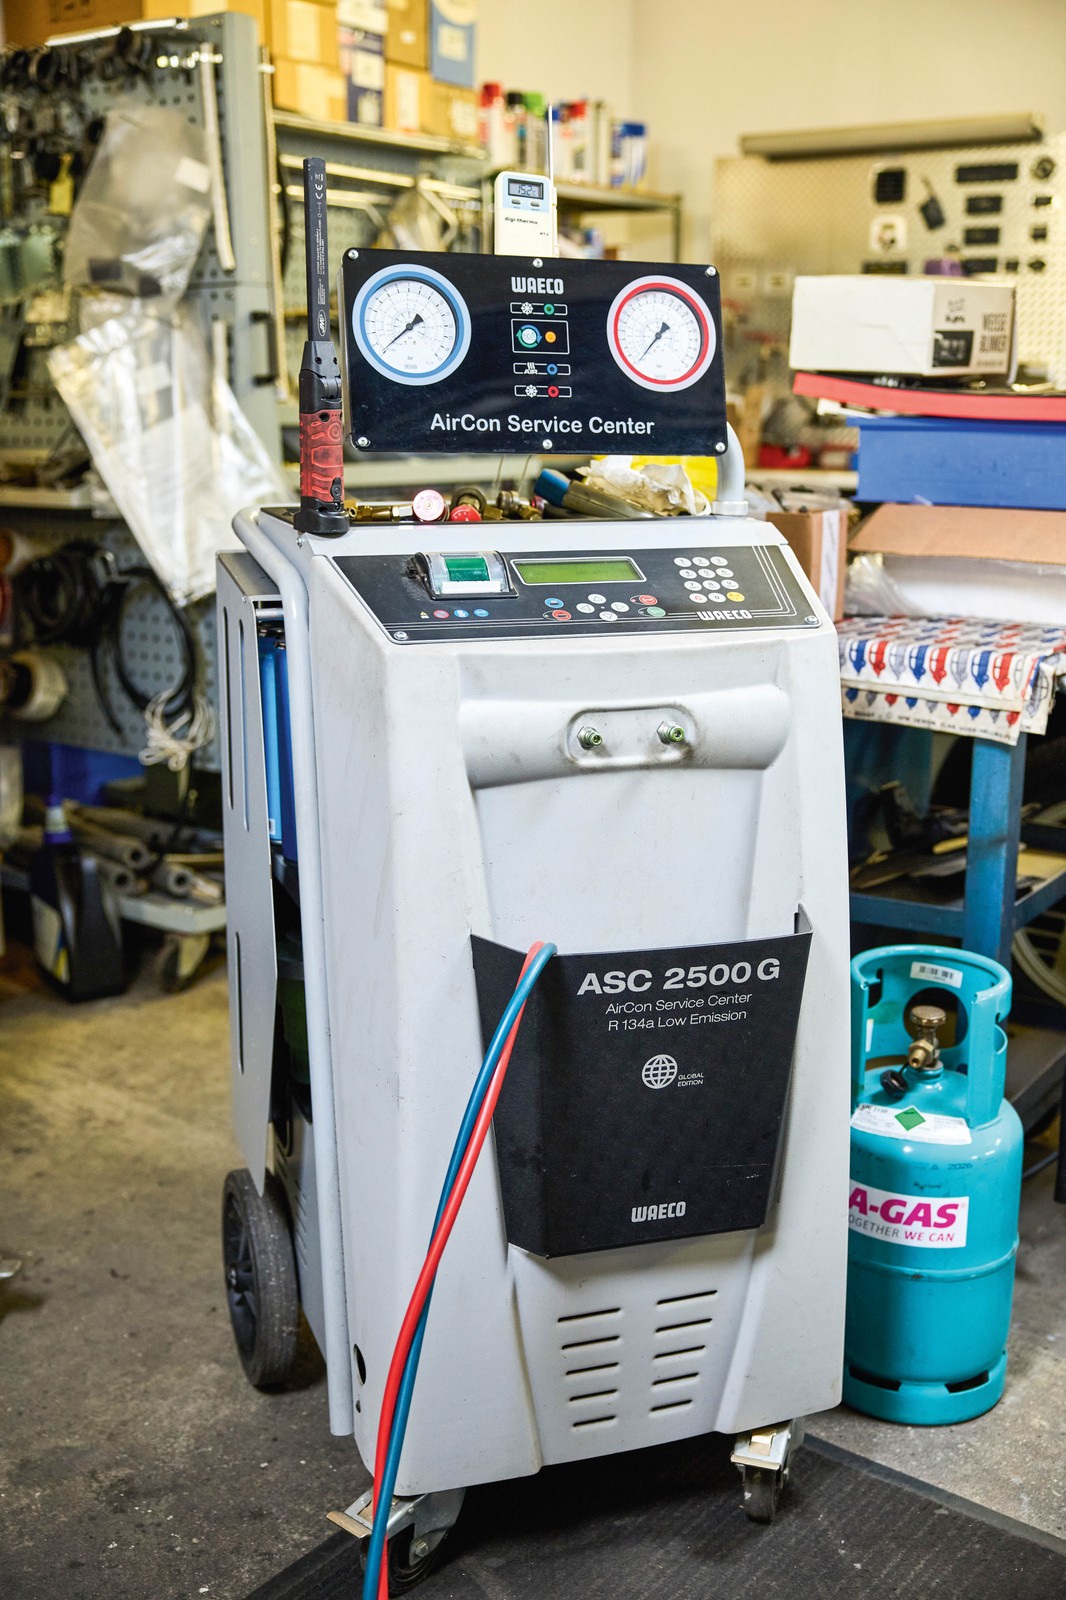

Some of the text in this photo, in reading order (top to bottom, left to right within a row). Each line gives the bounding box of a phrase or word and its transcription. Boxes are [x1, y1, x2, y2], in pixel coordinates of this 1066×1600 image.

[511, 276, 564, 295] WAECO
[430, 413, 655, 435] AirCon Service Center
[696, 609, 753, 621] WAECO
[577, 957, 781, 996] ASC 2500 G
[605, 993, 752, 1015] AirCon Service Center
[608, 1010, 747, 1031] R 134a Low Emission
[677, 1079, 704, 1087] EDITION
[678, 1072, 704, 1080] GLOBAL
[631, 1201, 687, 1223] WAECO
[849, 1187, 959, 1229] A-GAS
[849, 1214, 955, 1243] OGETHER WE CAN
